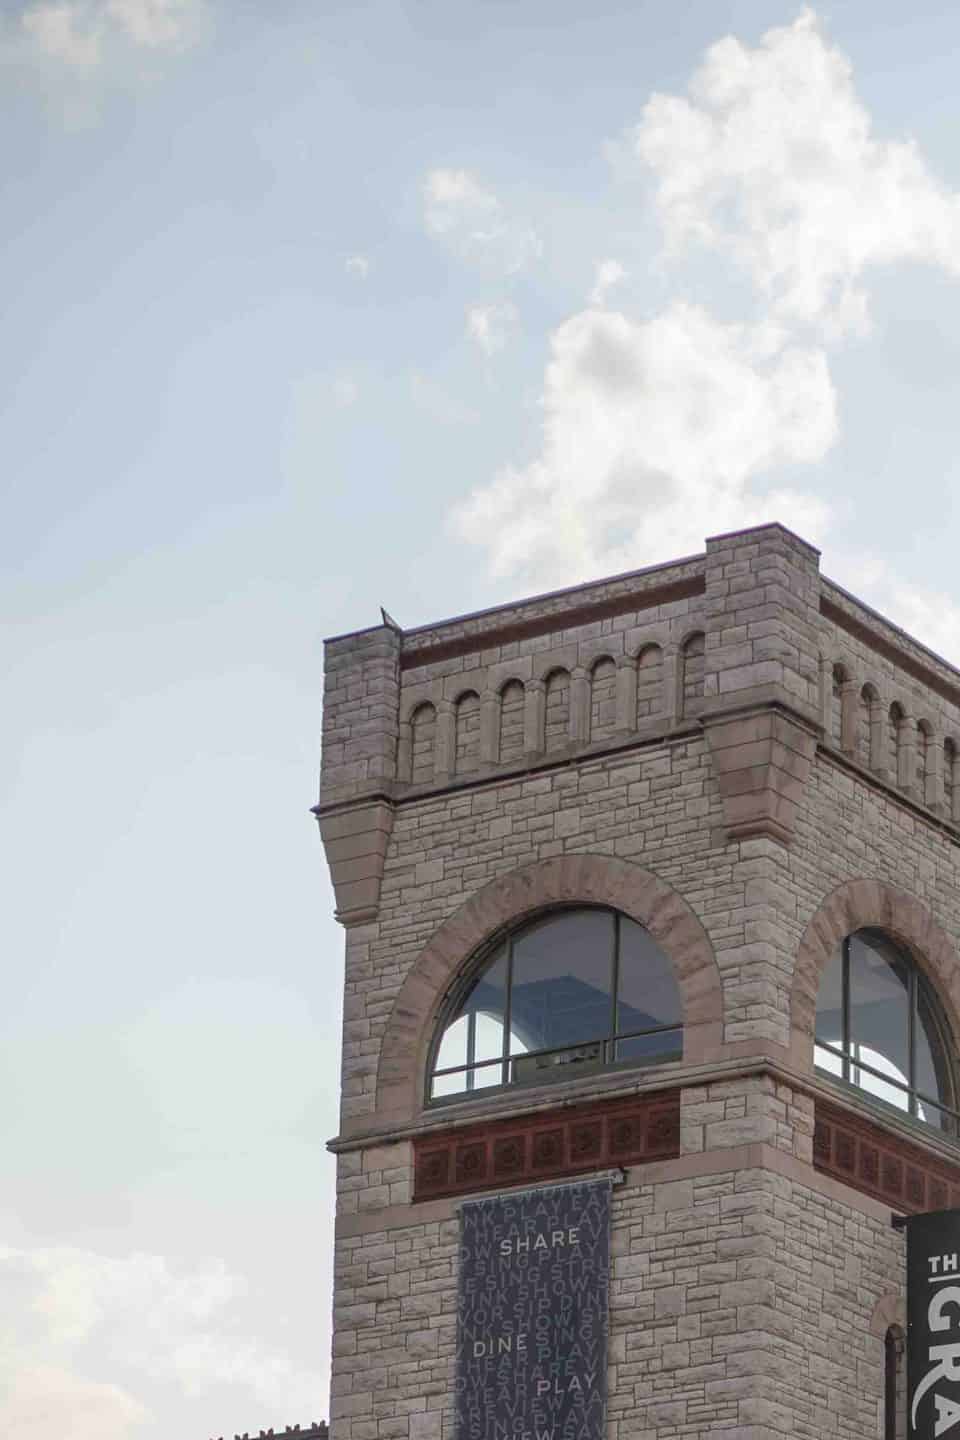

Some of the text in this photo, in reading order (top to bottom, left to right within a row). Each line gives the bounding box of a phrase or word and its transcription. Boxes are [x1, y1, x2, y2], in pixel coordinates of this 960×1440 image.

[505, 1200, 560, 1219] PLAY
[475, 1207, 606, 1243] HEAR PLAY
[500, 1227, 580, 1256] SHARE
[539, 1242, 599, 1265] PLAY
[486, 1267, 540, 1290] SING
[518, 1276, 589, 1300] SHOW
[513, 1298, 551, 1318] SIP
[503, 1311, 571, 1336] SHOW
[473, 1325, 593, 1358] DINE SING
[467, 1339, 596, 1374] HEAR PLAY
[466, 1373, 596, 1409] HEAR PLAY
[505, 1397, 563, 1417] VIEW
[534, 1407, 593, 1429] PLAY
